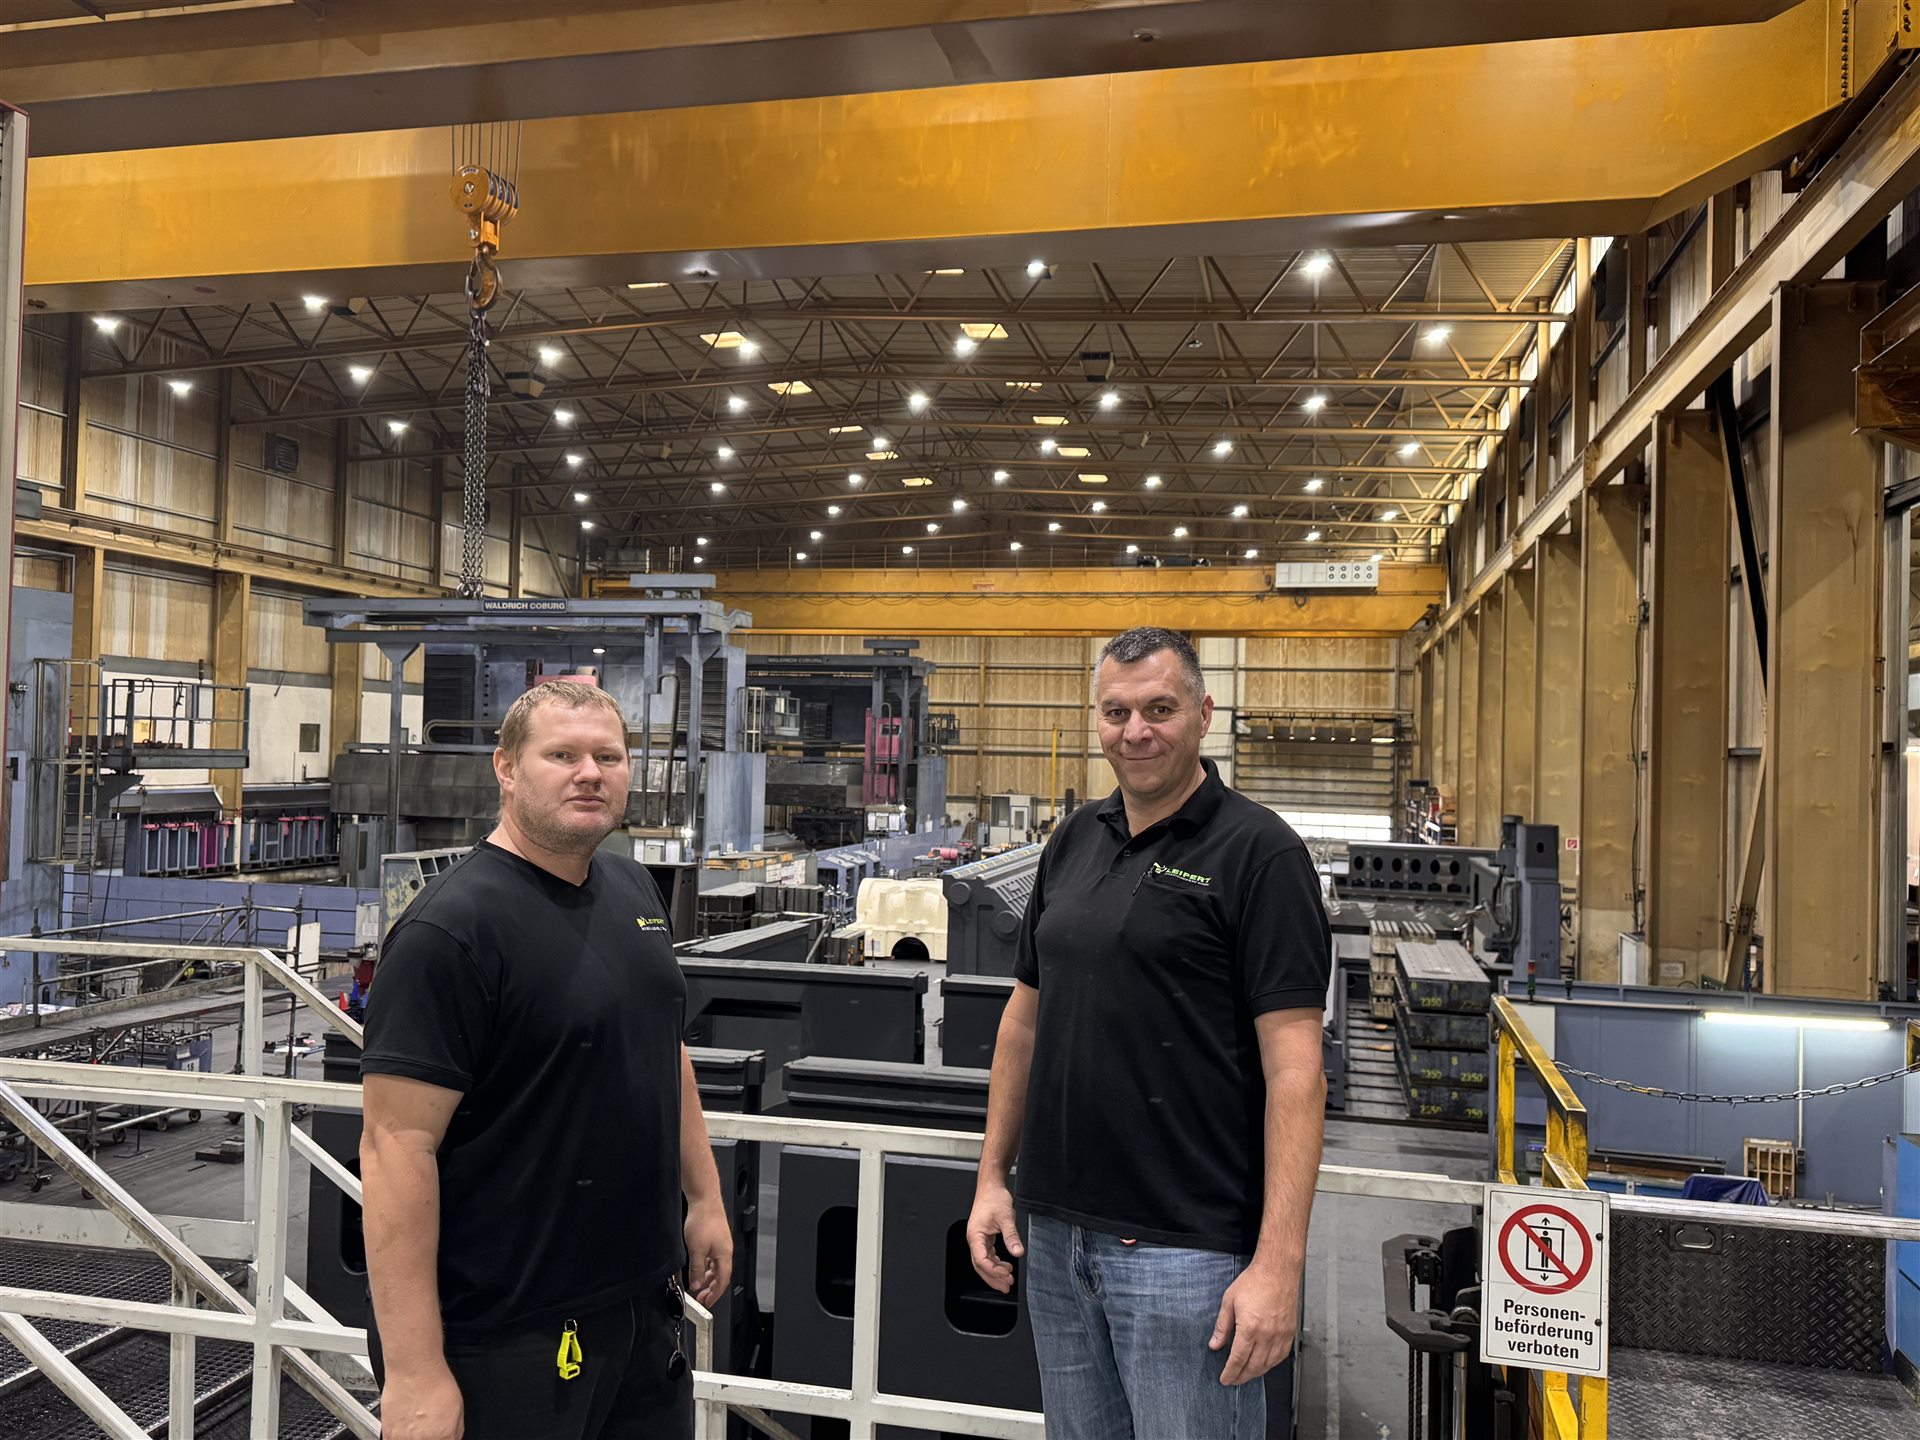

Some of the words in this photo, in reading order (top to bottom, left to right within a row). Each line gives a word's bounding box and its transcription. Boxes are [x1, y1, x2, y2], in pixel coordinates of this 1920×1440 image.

[485, 602, 528, 610] WALDRICH
[529, 602, 565, 610] COBURG
[1165, 868, 1212, 884] LEIPERT
[1461, 1072, 1483, 1082] 2350
[1503, 1299, 1586, 1322] Personen-
[1494, 1317, 1594, 1345] beförderung
[1507, 1339, 1580, 1359] verboten
